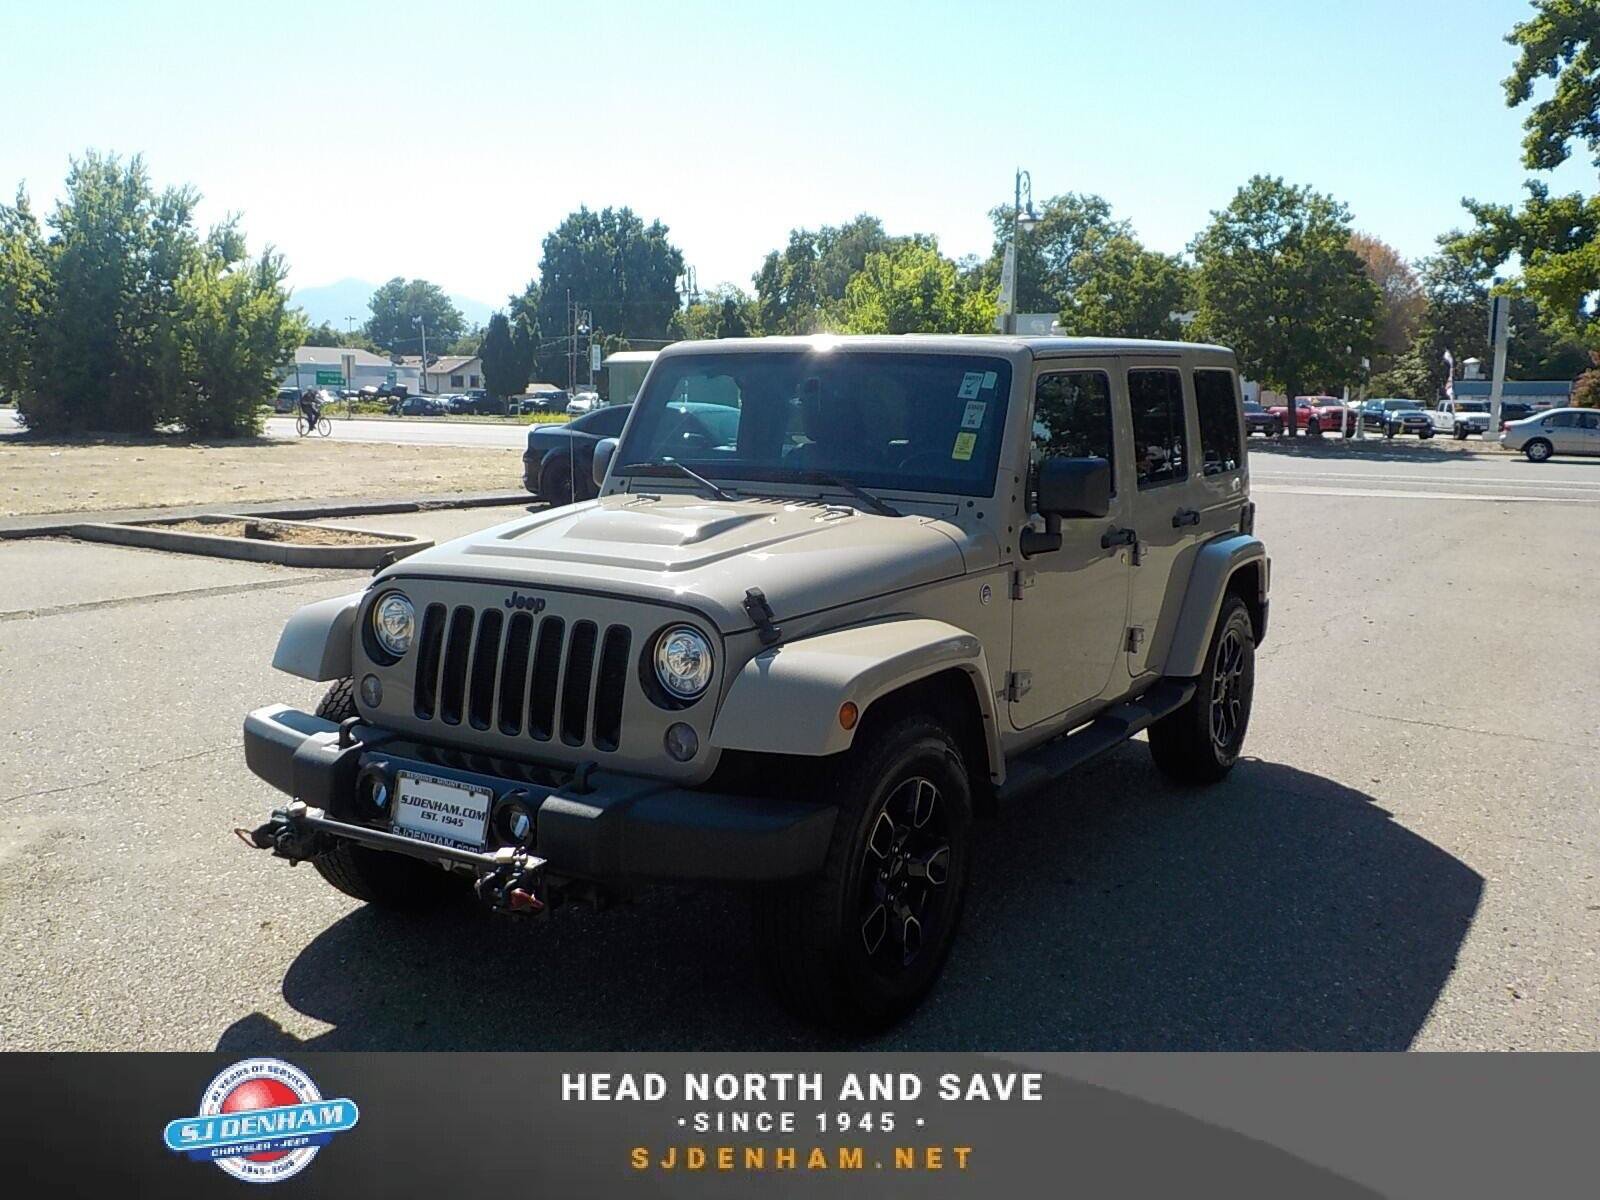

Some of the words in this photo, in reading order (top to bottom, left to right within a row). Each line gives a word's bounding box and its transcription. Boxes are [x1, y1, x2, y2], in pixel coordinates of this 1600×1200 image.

[505, 591, 546, 614] Jeep
[400, 794, 486, 822] SJDENHAM.COM
[420, 811, 438, 822] EST.
[441, 815, 464, 827] 1945
[392, 825, 481, 853] SJDENHAMcom
